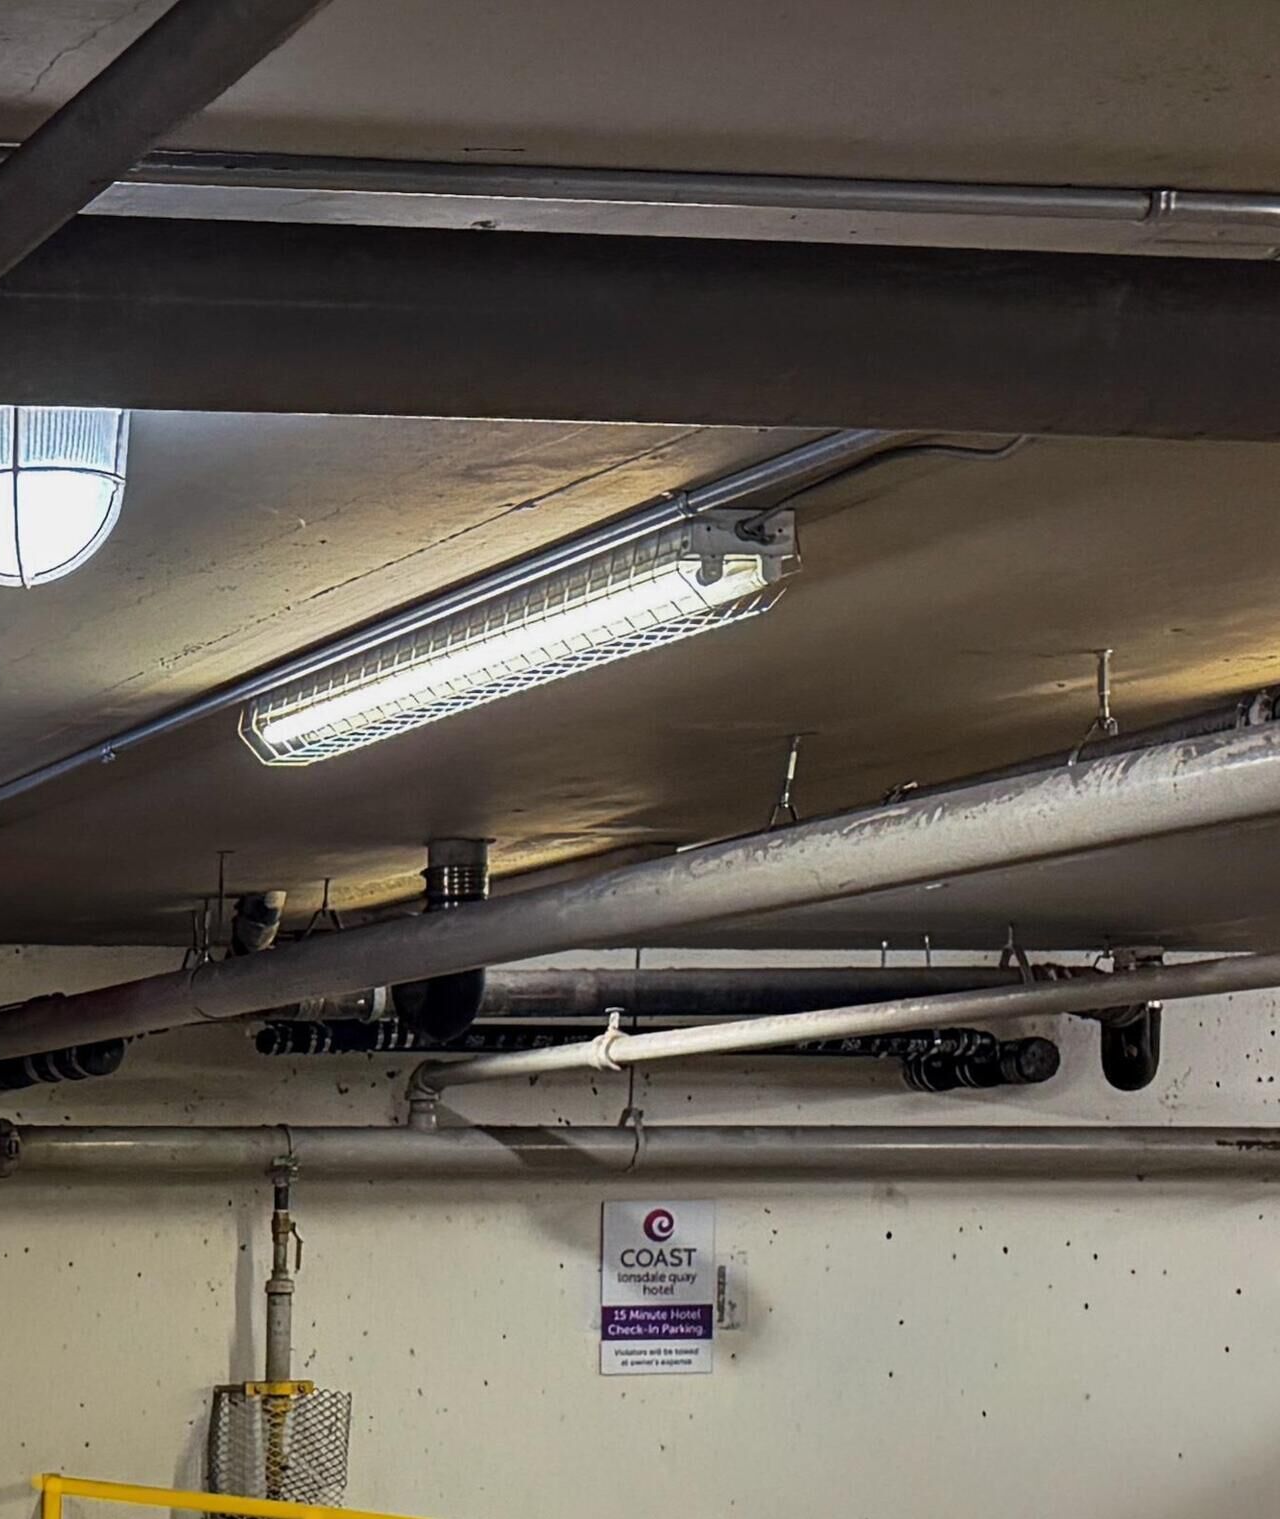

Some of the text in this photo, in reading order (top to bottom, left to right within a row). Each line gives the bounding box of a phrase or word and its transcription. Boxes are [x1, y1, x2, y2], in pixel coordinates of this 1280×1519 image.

[621, 1249, 697, 1268] COAST
[618, 1272, 697, 1285] lonsdale quay
[643, 1285, 674, 1296] hotel
[614, 1309, 701, 1320] 15 Minute Hotel
[608, 1324, 703, 1336] Check-In Parking
